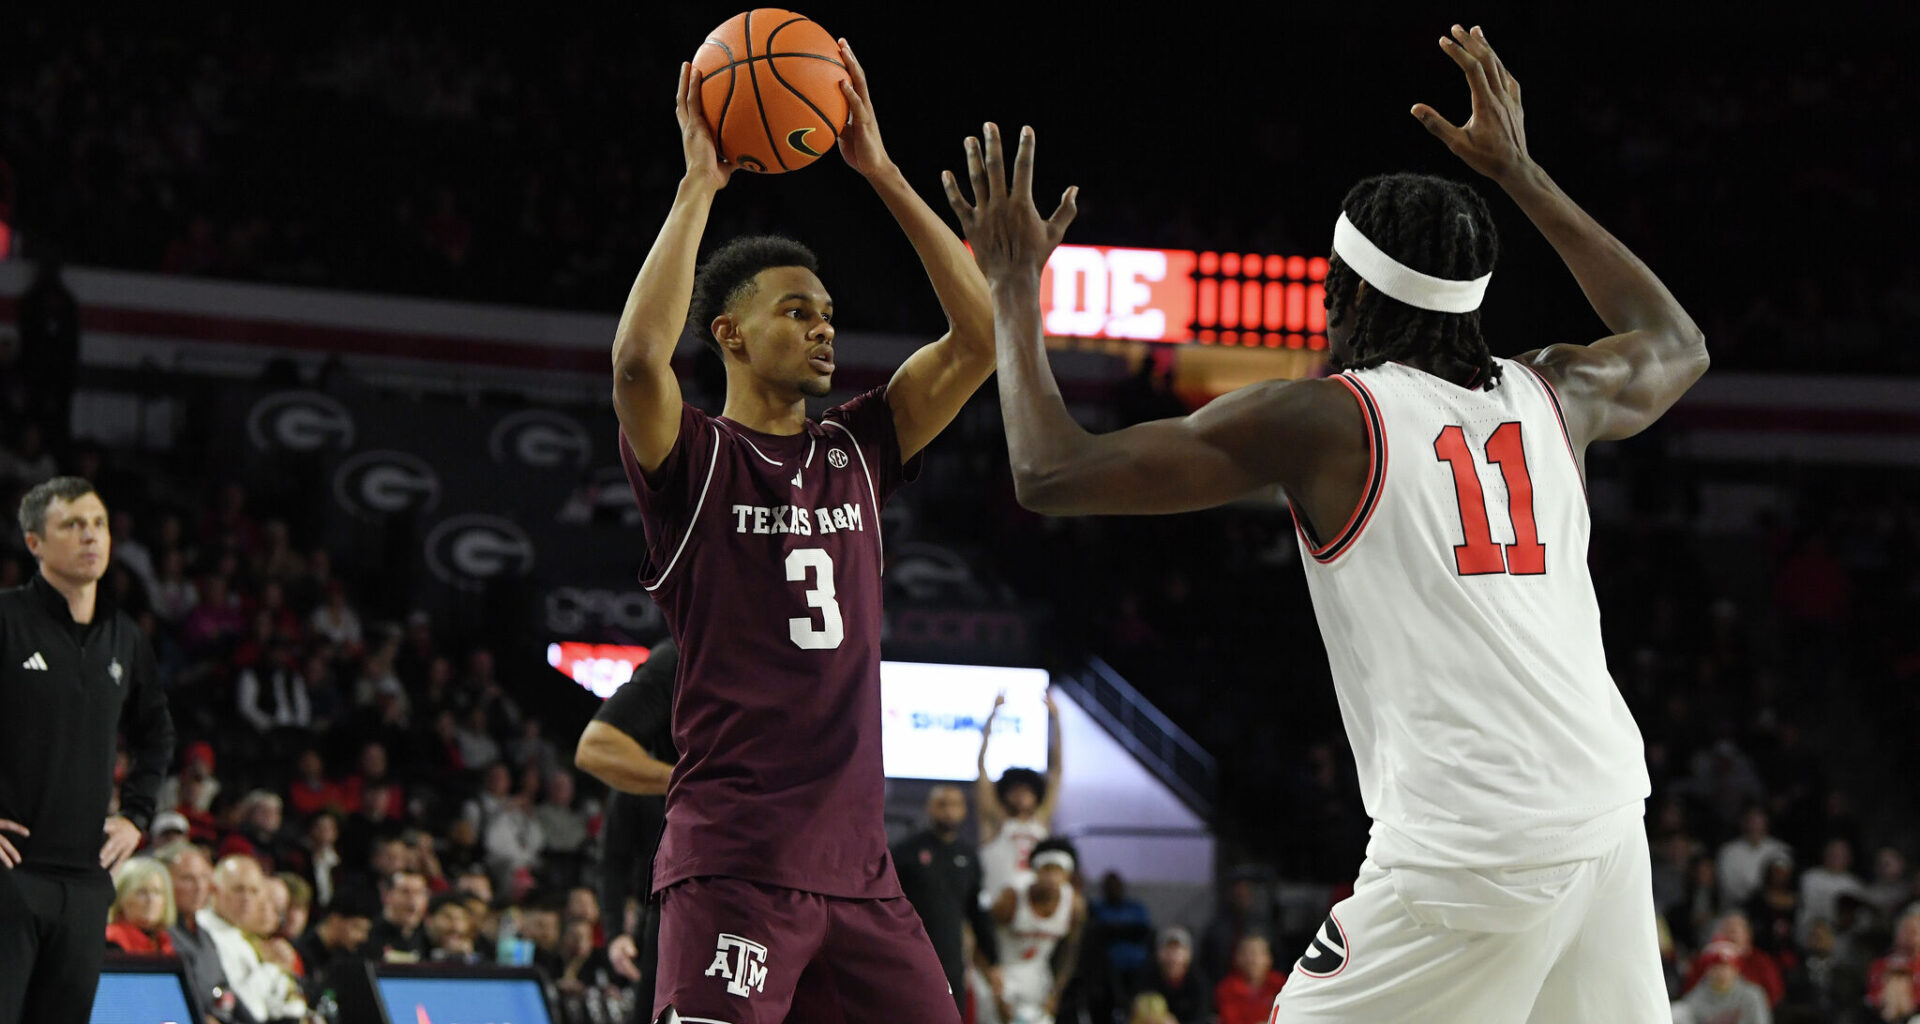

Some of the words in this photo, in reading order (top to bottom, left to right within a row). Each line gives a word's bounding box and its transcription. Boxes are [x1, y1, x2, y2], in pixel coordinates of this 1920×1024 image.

[829, 450, 847, 467] SEC
[732, 504, 812, 536] TEXAS
[815, 503, 864, 535] A&M
[1433, 421, 1546, 576] 11
[785, 548, 845, 650] 3
